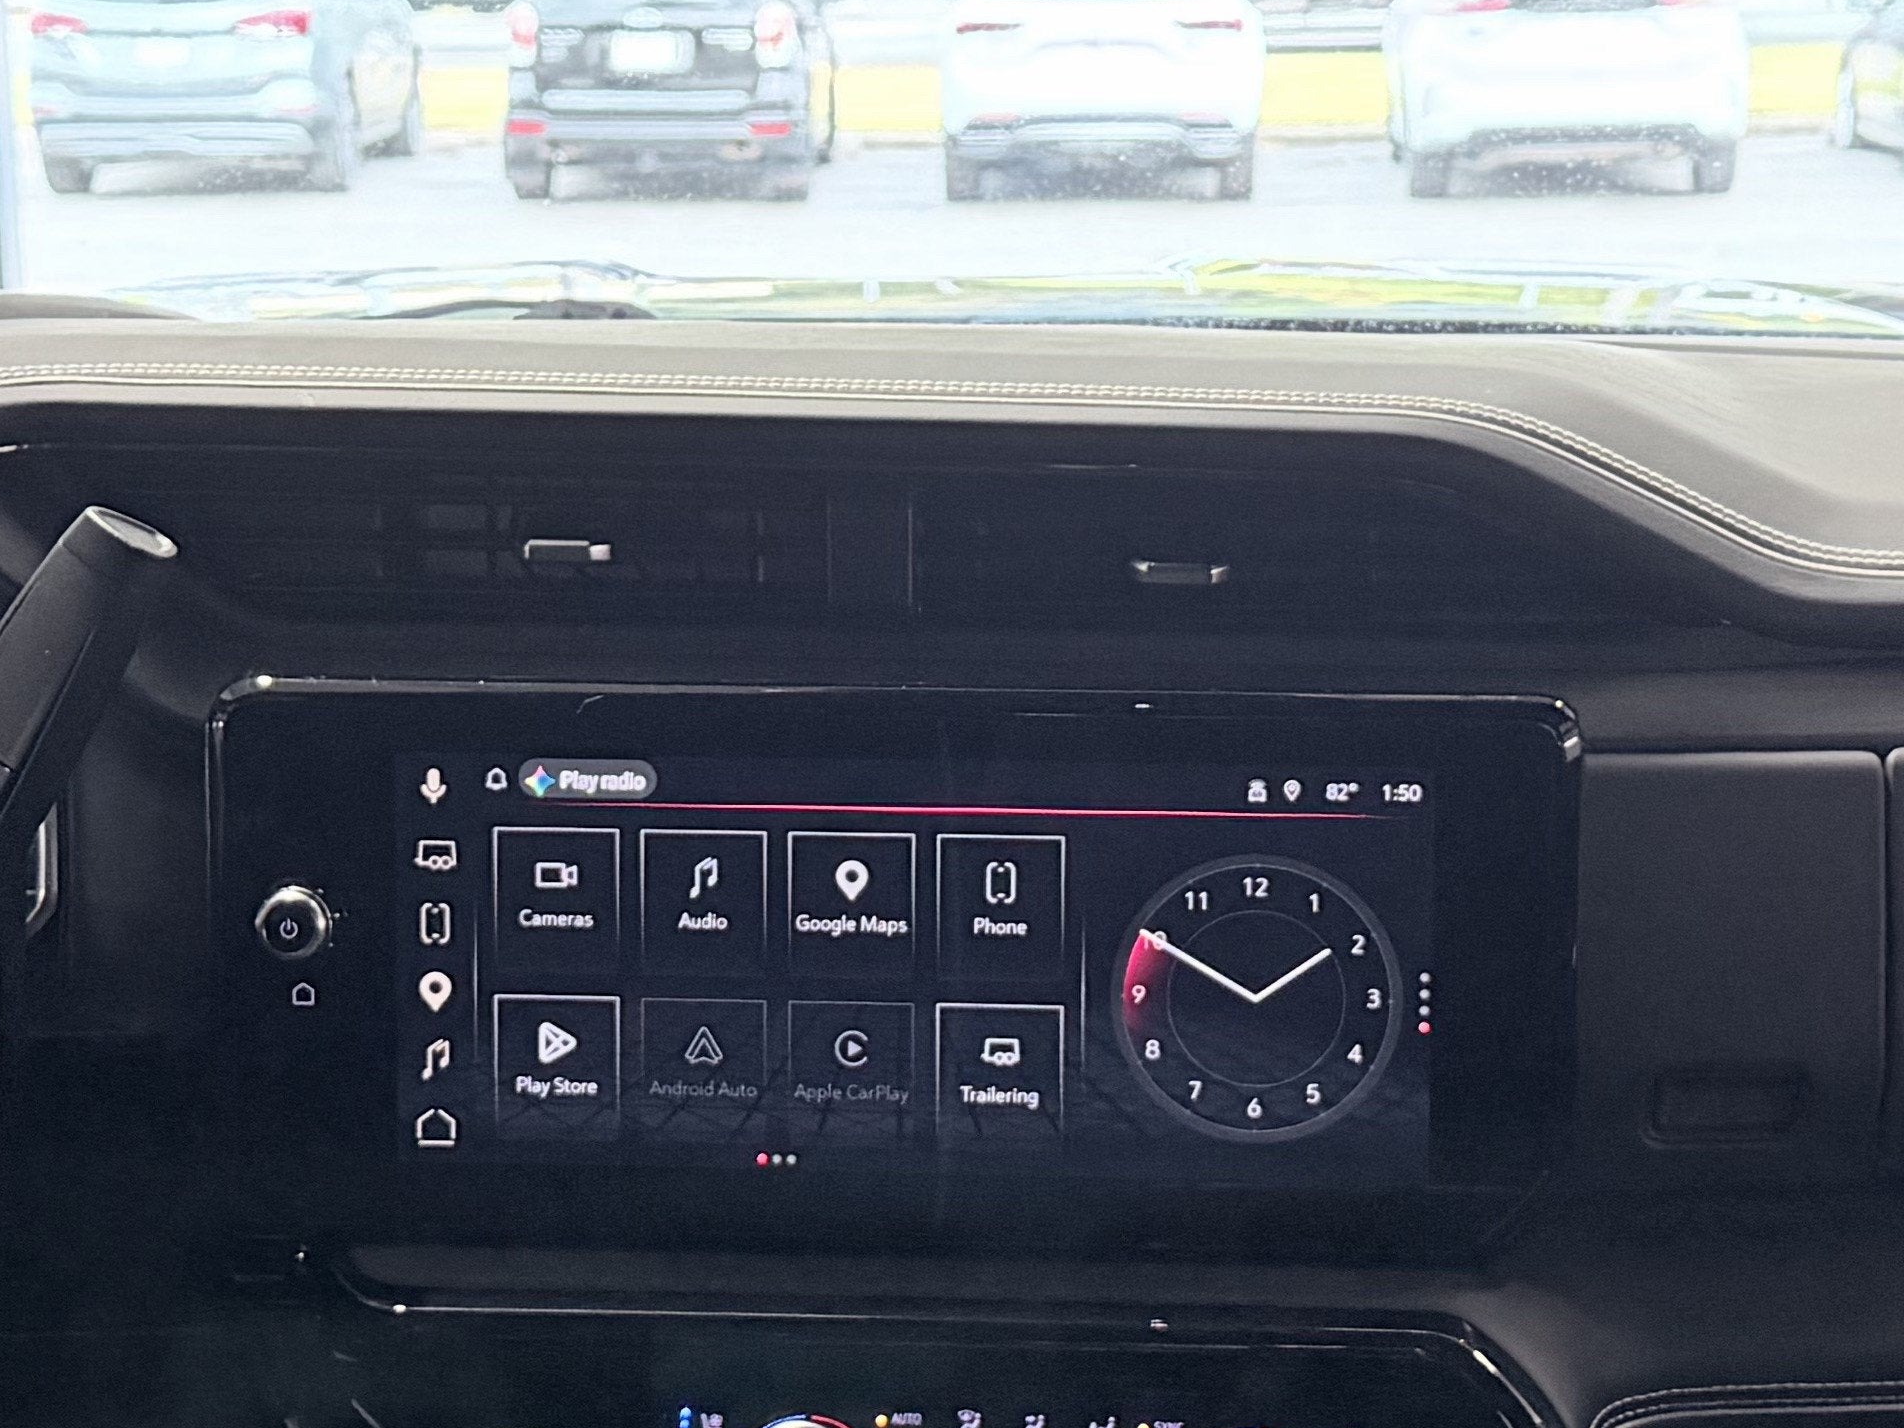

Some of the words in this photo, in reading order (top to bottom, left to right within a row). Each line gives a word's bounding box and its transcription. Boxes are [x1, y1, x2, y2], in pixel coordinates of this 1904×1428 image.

[558, 770, 599, 793] Play
[600, 770, 647, 792] radio
[1325, 781, 1360, 802] 82°
[1382, 783, 1424, 803] 1:50
[1242, 876, 1270, 899] 12
[1184, 890, 1209, 912] 11
[1308, 892, 1321, 914] 1
[518, 908, 595, 928] Cameras
[678, 911, 728, 931] Audio
[795, 913, 856, 937] Google
[859, 915, 909, 937] Maps
[973, 916, 1028, 936] Phone
[1350, 934, 1367, 956] 2
[1131, 984, 1147, 1005] 9
[1366, 988, 1383, 1010] 3
[1144, 1039, 1162, 1061] 8
[1347, 1043, 1364, 1066] 4
[515, 1075, 551, 1100] Play
[553, 1076, 598, 1096] Store
[649, 1079, 715, 1097] Android
[718, 1080, 758, 1097] Auto
[794, 1083, 843, 1103] Apple
[845, 1083, 910, 1105] CarPlay
[959, 1084, 1040, 1110] Trailering
[1188, 1079, 1203, 1102] 7
[1305, 1083, 1322, 1105] 5
[1246, 1097, 1263, 1119] 6
[891, 1412, 923, 1426] AUTO
